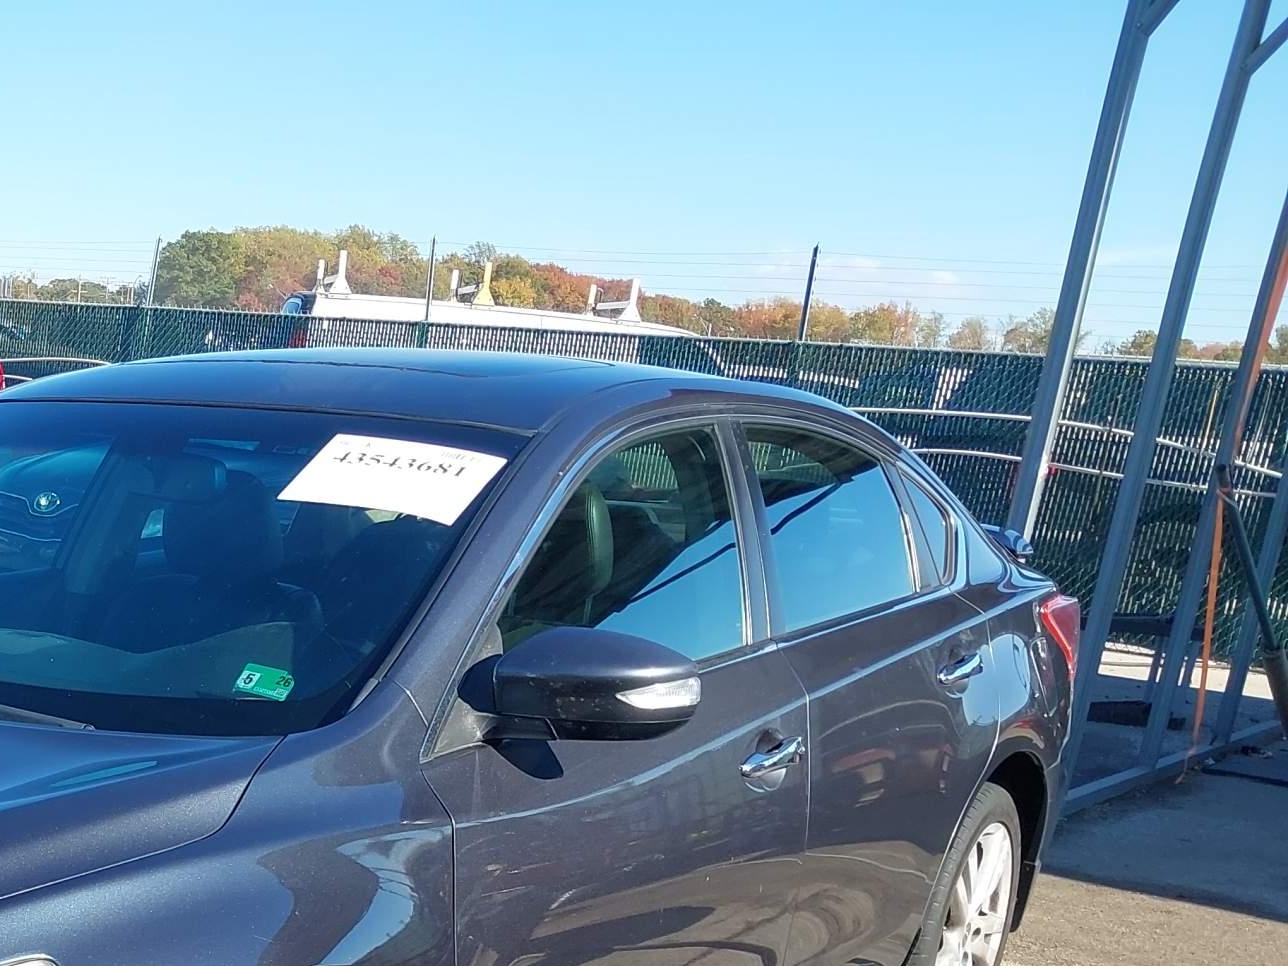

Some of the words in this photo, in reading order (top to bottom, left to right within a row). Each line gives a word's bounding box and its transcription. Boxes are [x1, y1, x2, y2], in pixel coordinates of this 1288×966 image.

[333, 451, 466, 477] 43543681
[243, 673, 256, 685] 5
[276, 676, 292, 687] 26
